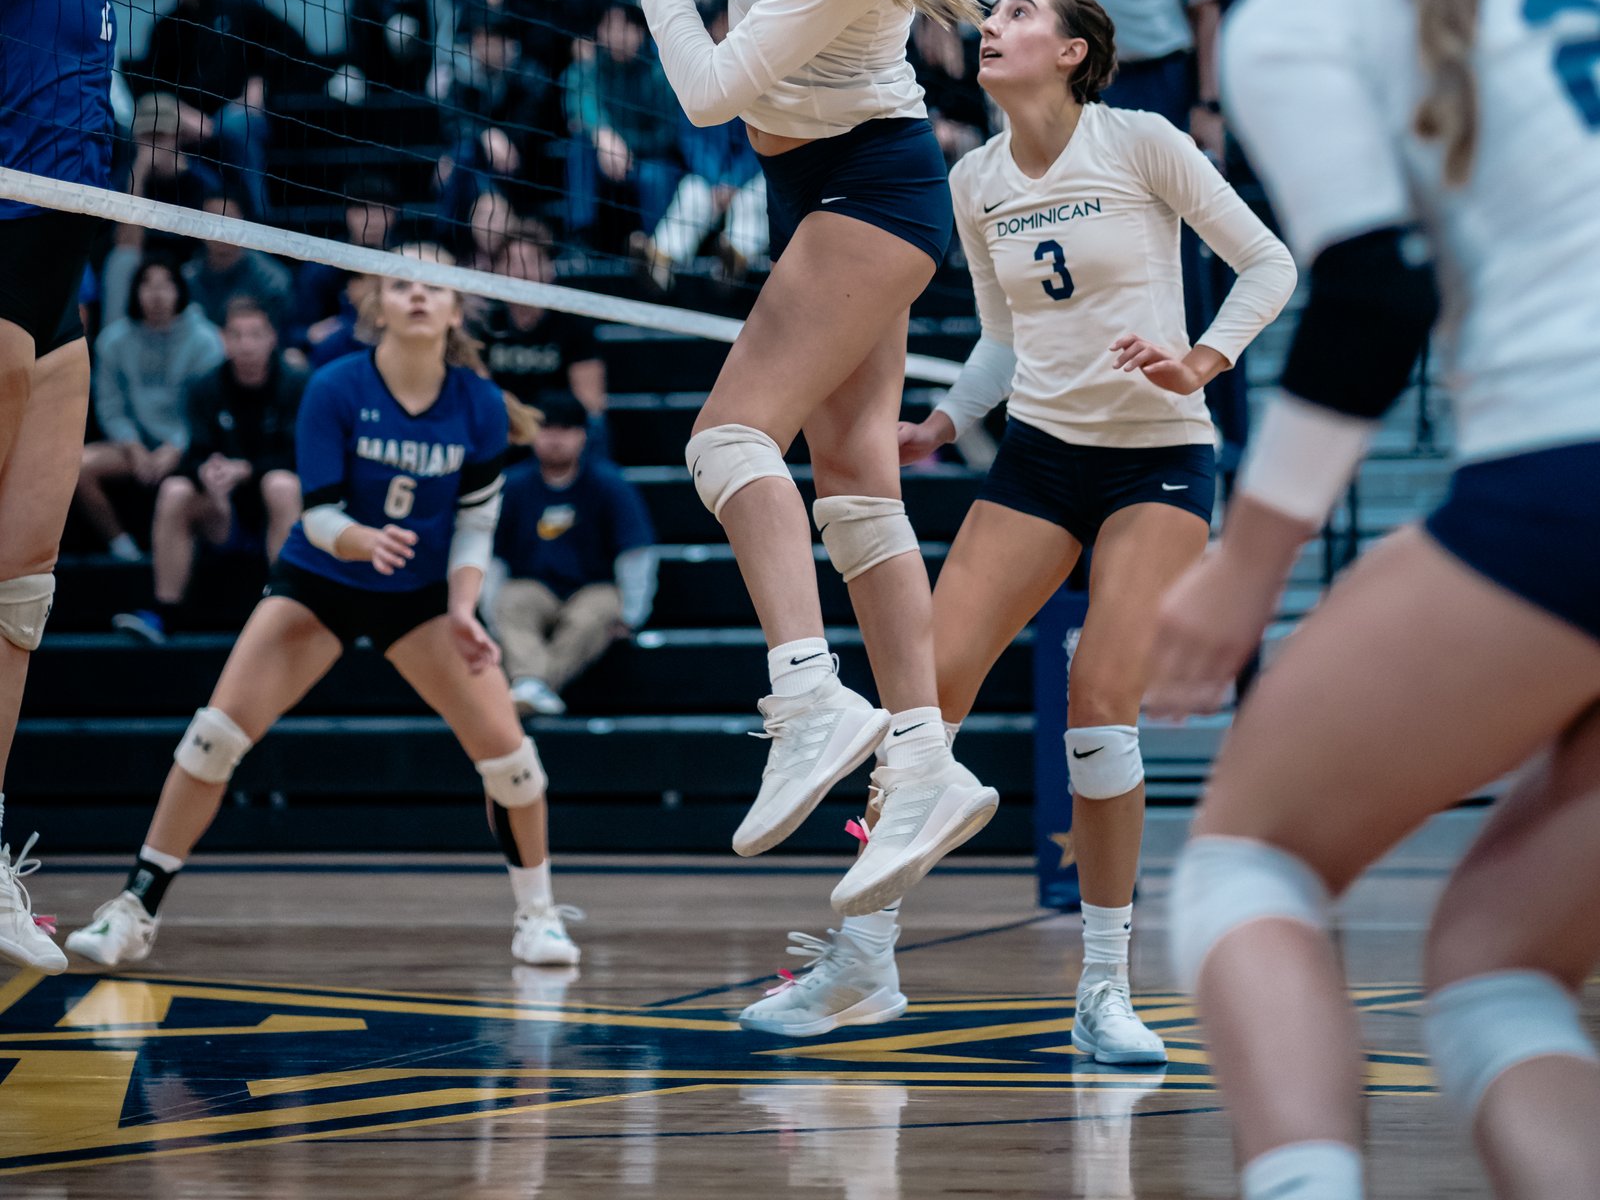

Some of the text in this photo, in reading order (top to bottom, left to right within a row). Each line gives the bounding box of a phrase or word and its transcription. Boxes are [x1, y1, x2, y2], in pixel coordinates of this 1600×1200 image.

[997, 198, 1101, 237] DOMINICAN
[1034, 240, 1074, 301] 3
[356, 436, 466, 477] MARIAN
[383, 474, 417, 519] 6
